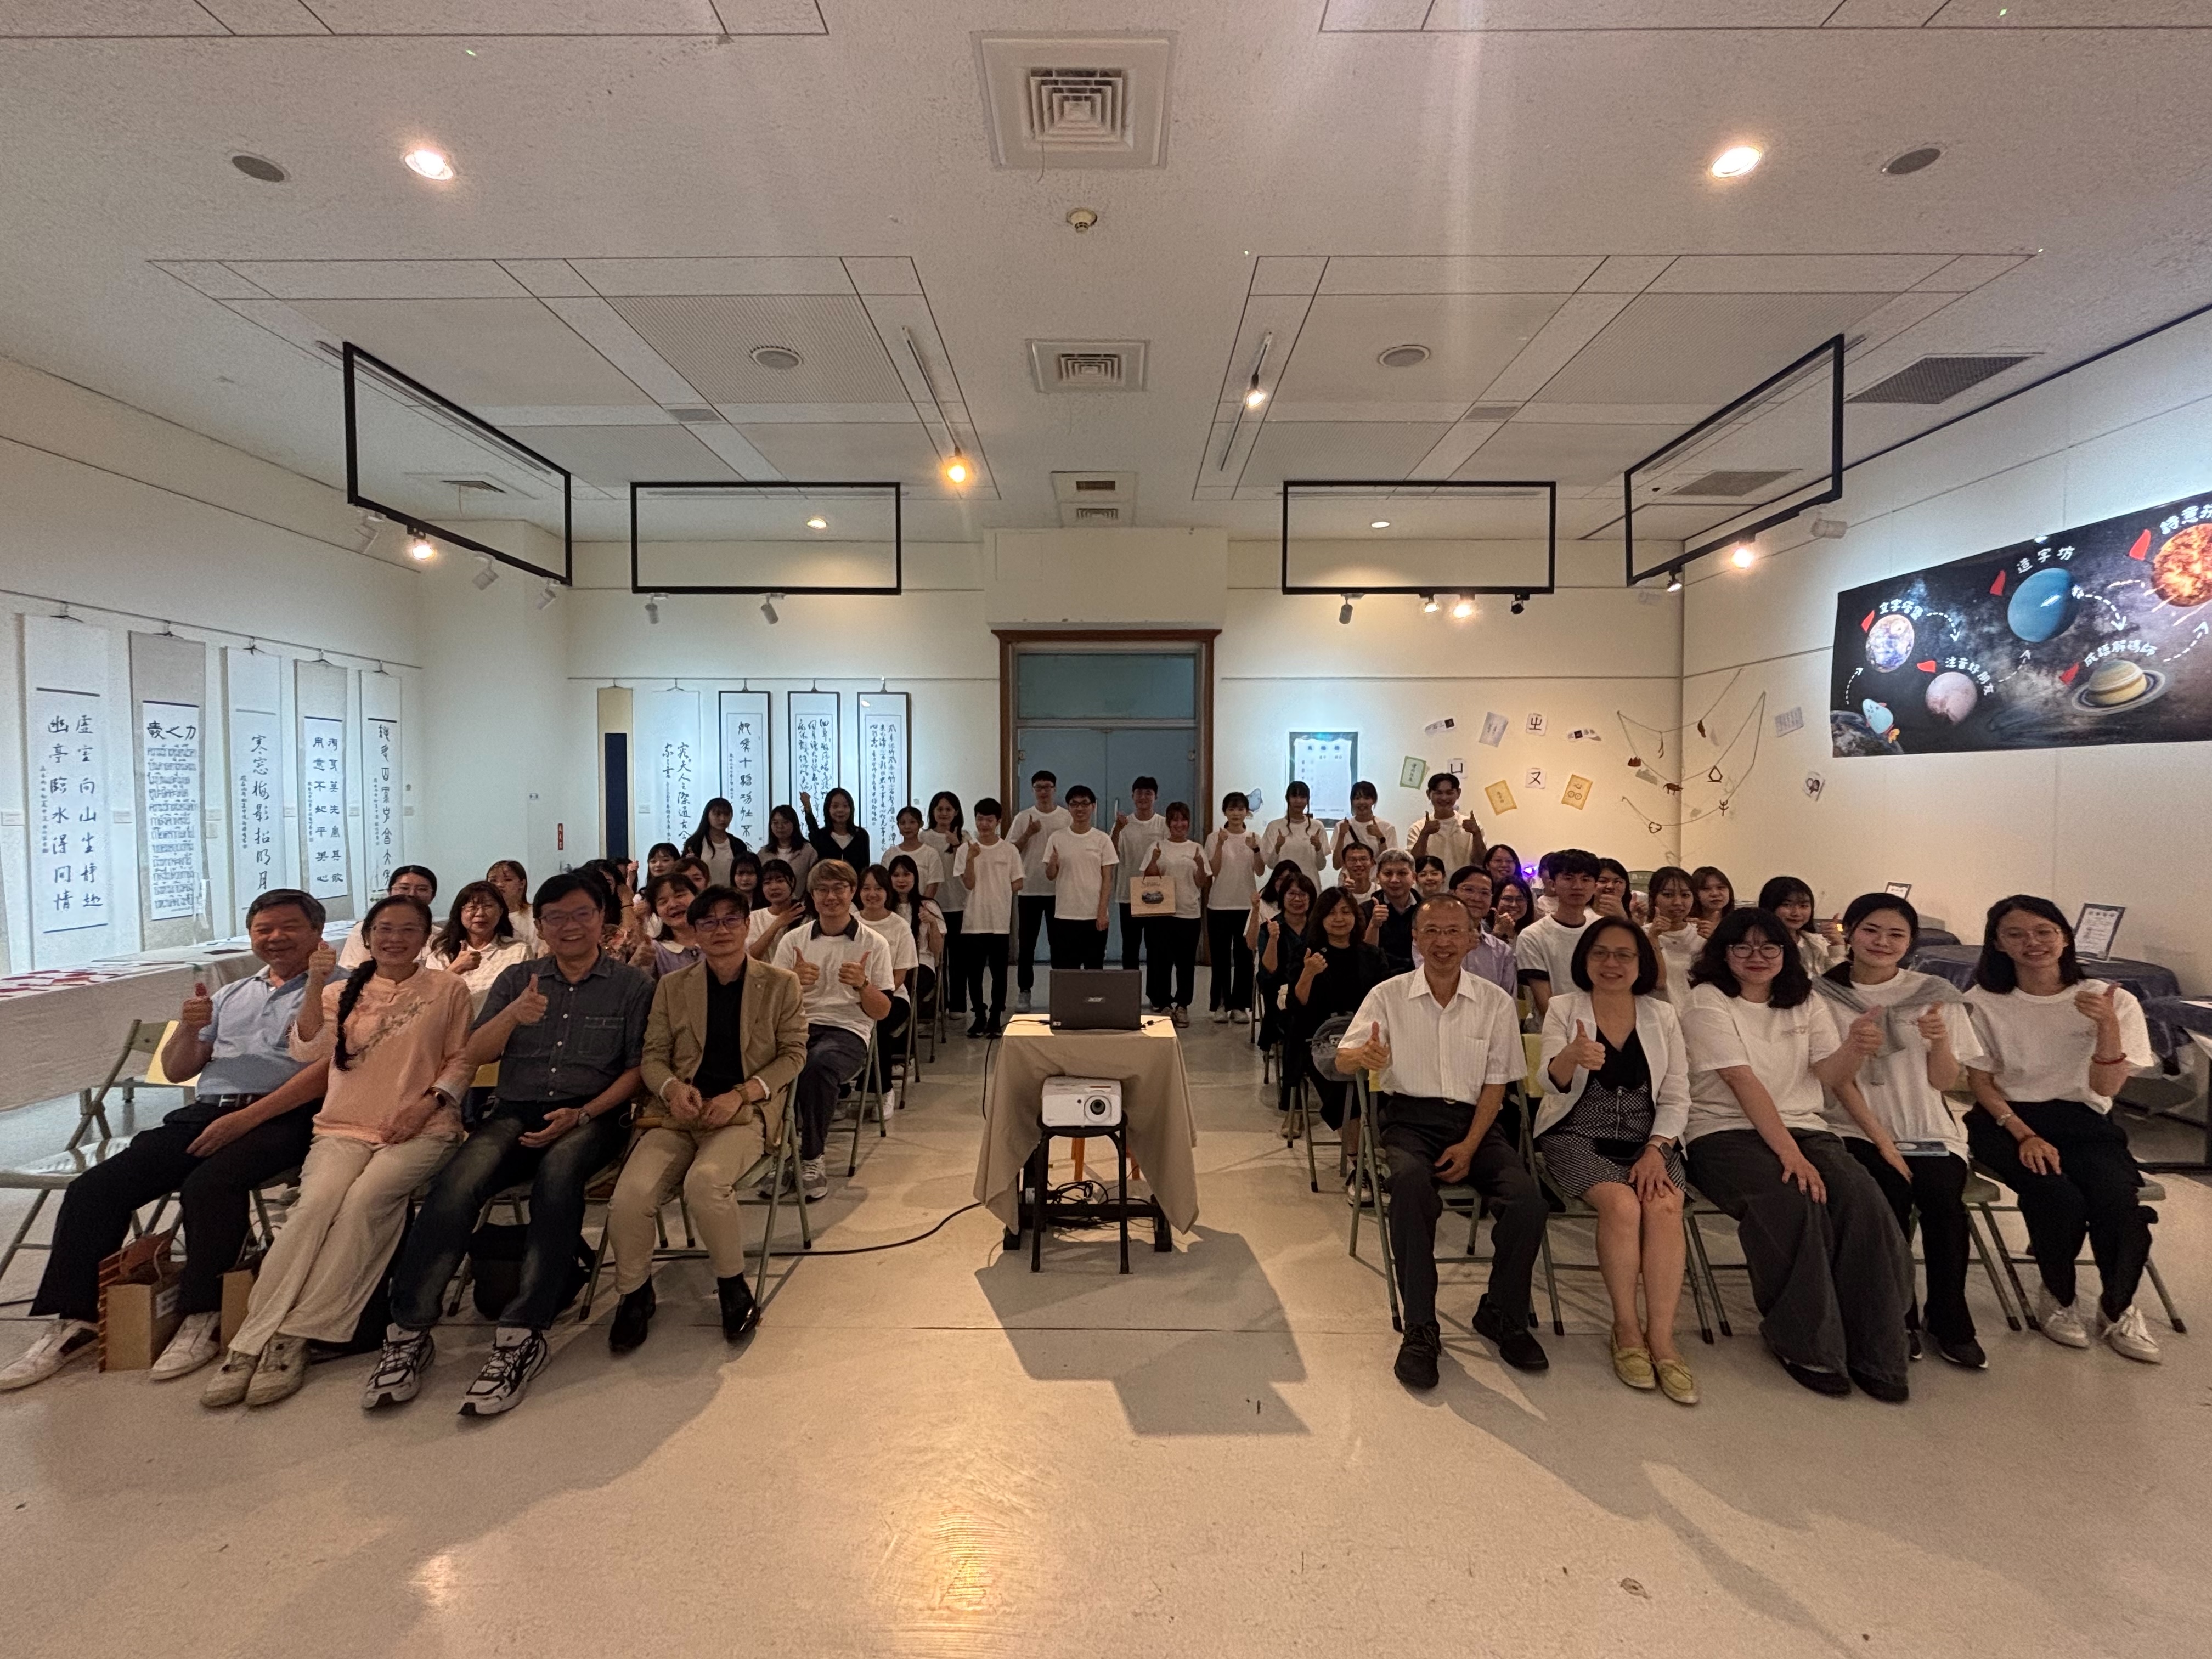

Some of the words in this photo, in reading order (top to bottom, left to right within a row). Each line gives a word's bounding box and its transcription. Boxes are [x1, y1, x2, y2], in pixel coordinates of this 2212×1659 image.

[2016, 546, 2075, 574] 造字坊
[1945, 656, 1994, 696] 注音好朋友
